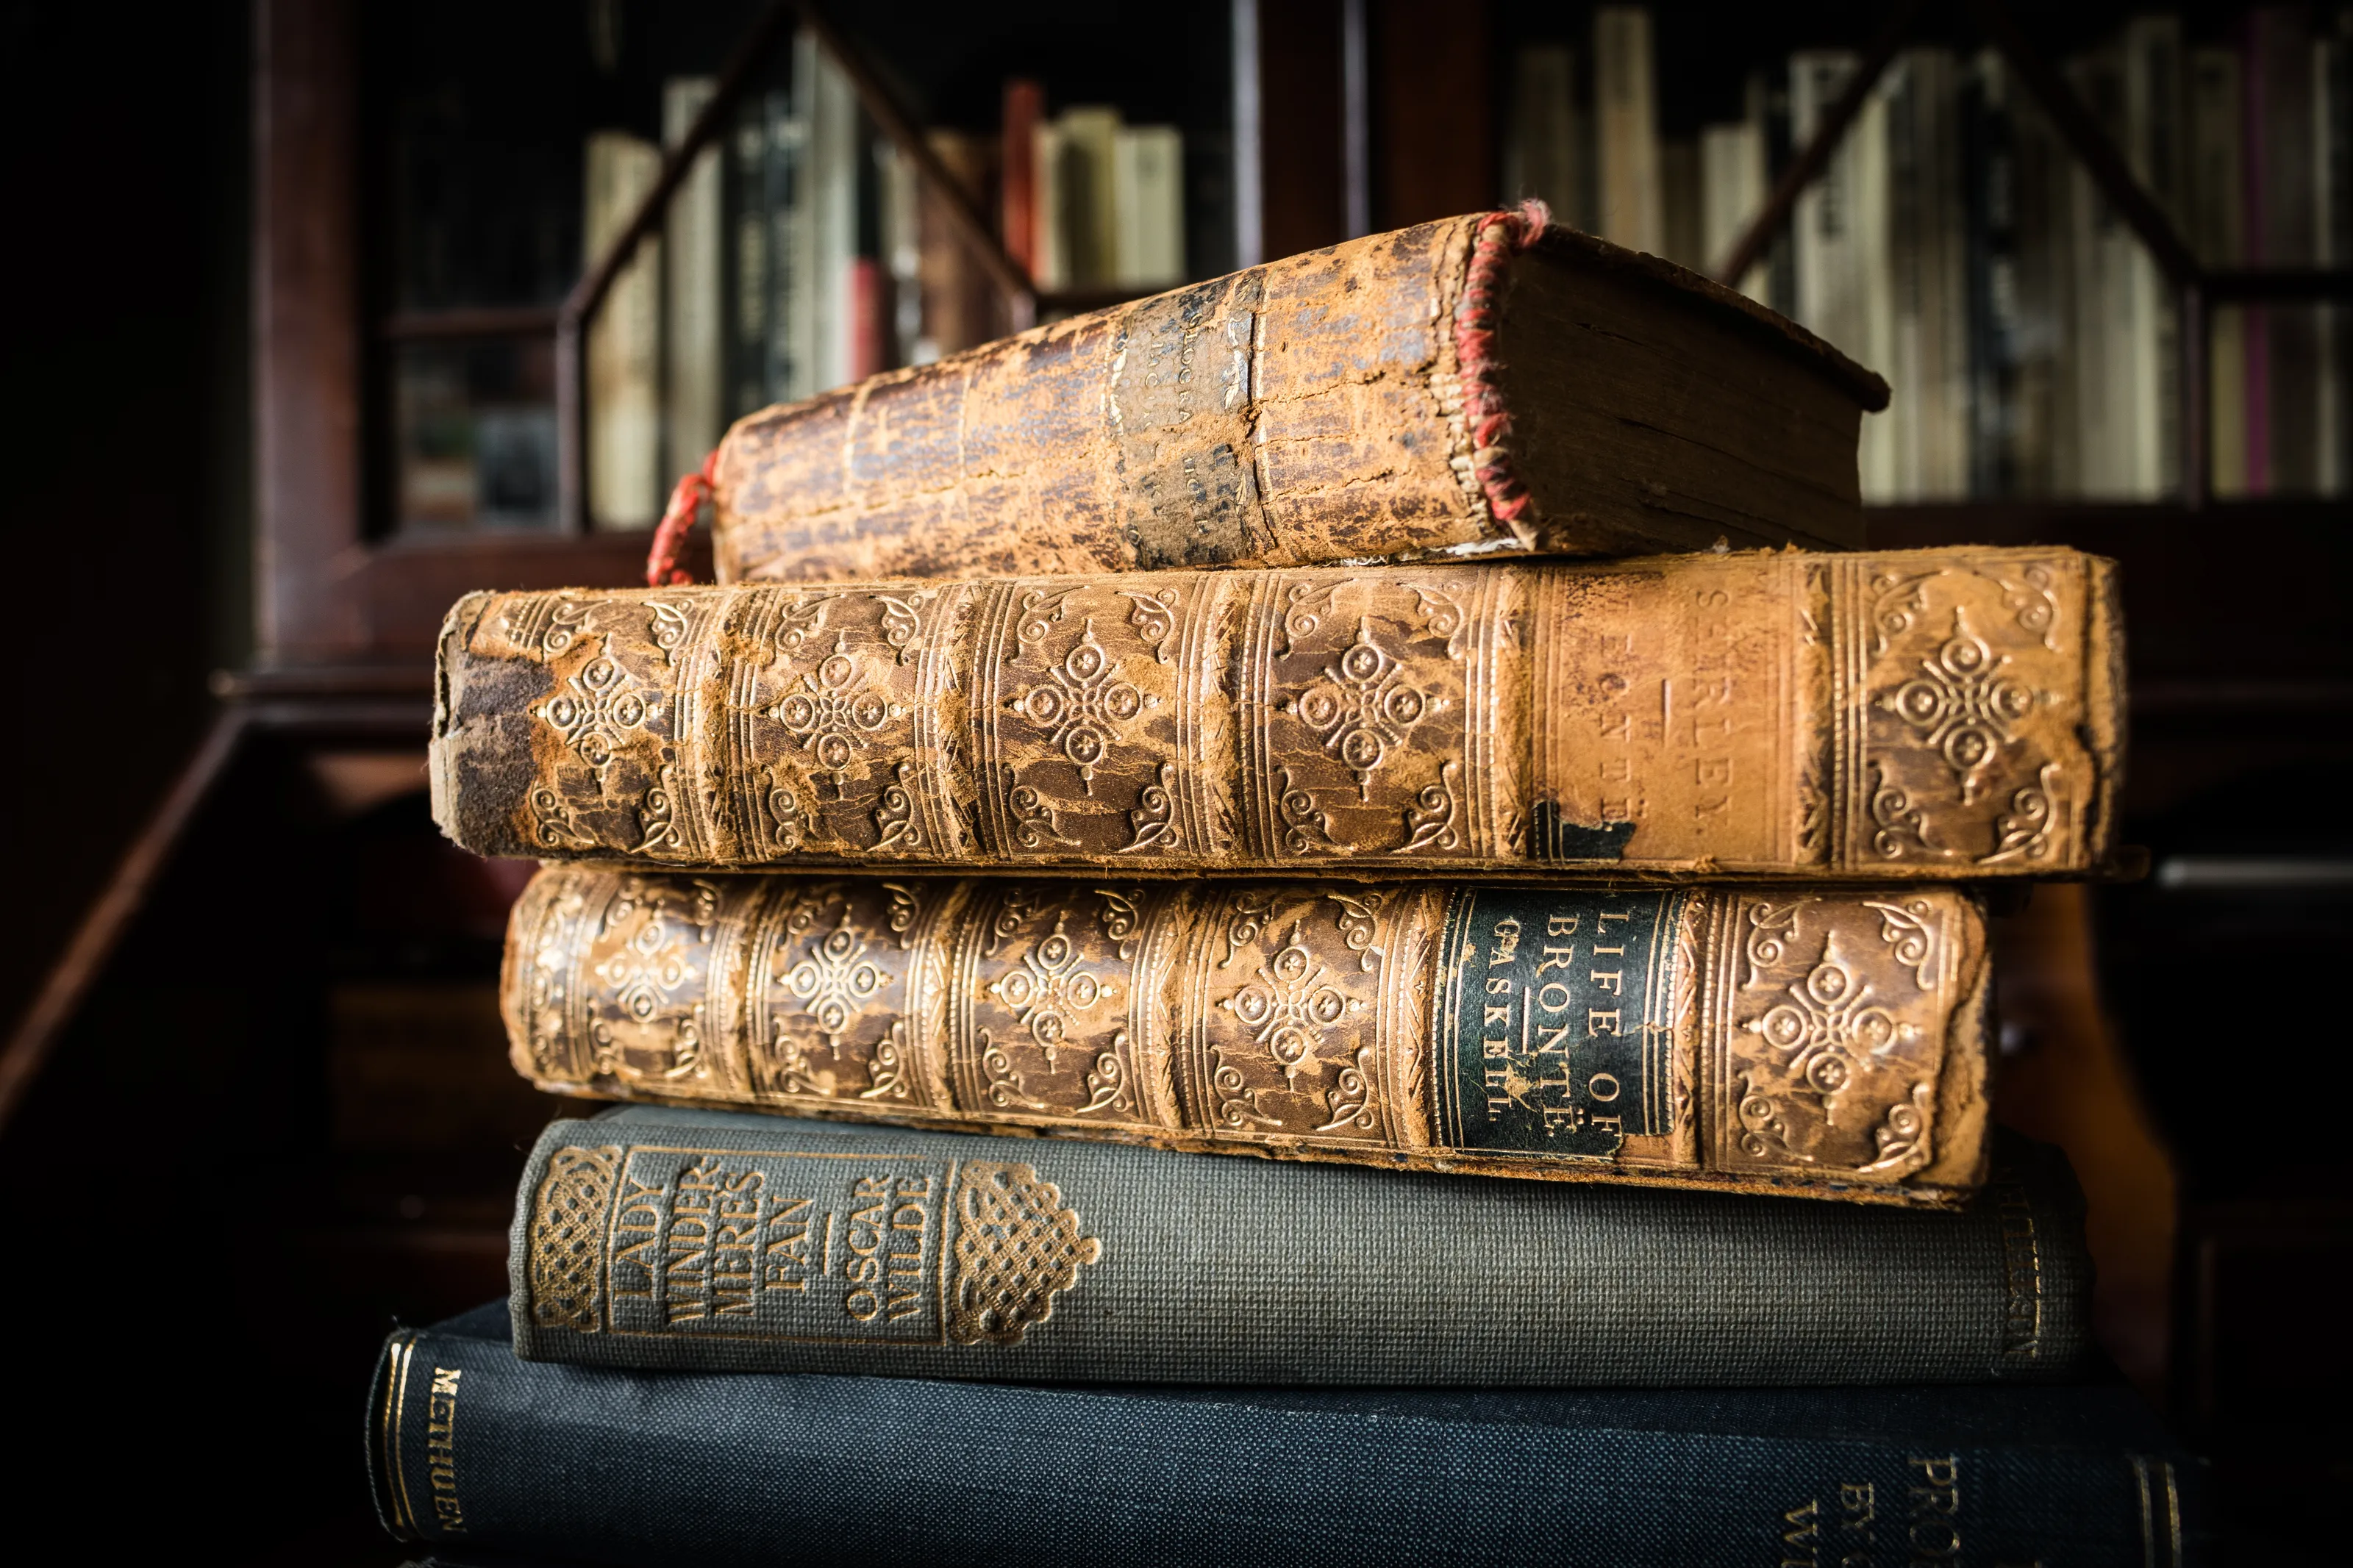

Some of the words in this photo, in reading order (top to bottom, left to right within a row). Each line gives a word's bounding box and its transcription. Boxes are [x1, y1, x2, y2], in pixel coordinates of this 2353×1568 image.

[1482, 919, 1520, 1123] GASKELL.
[1536, 914, 1585, 1137] BRONTË.
[1588, 911, 1629, 1038] LIFE
[1588, 1073, 1623, 1137] OF
[613, 1177, 663, 1300] LADY
[665, 1156, 721, 1323] WINDER-
[713, 1170, 765, 1316] MERE'S
[763, 1194, 813, 1293] FAN
[846, 1175, 890, 1322] OSCAR
[887, 1177, 929, 1322] WILDE
[428, 1367, 468, 1533] METHUEN
[1840, 1482, 1875, 1544] BY
